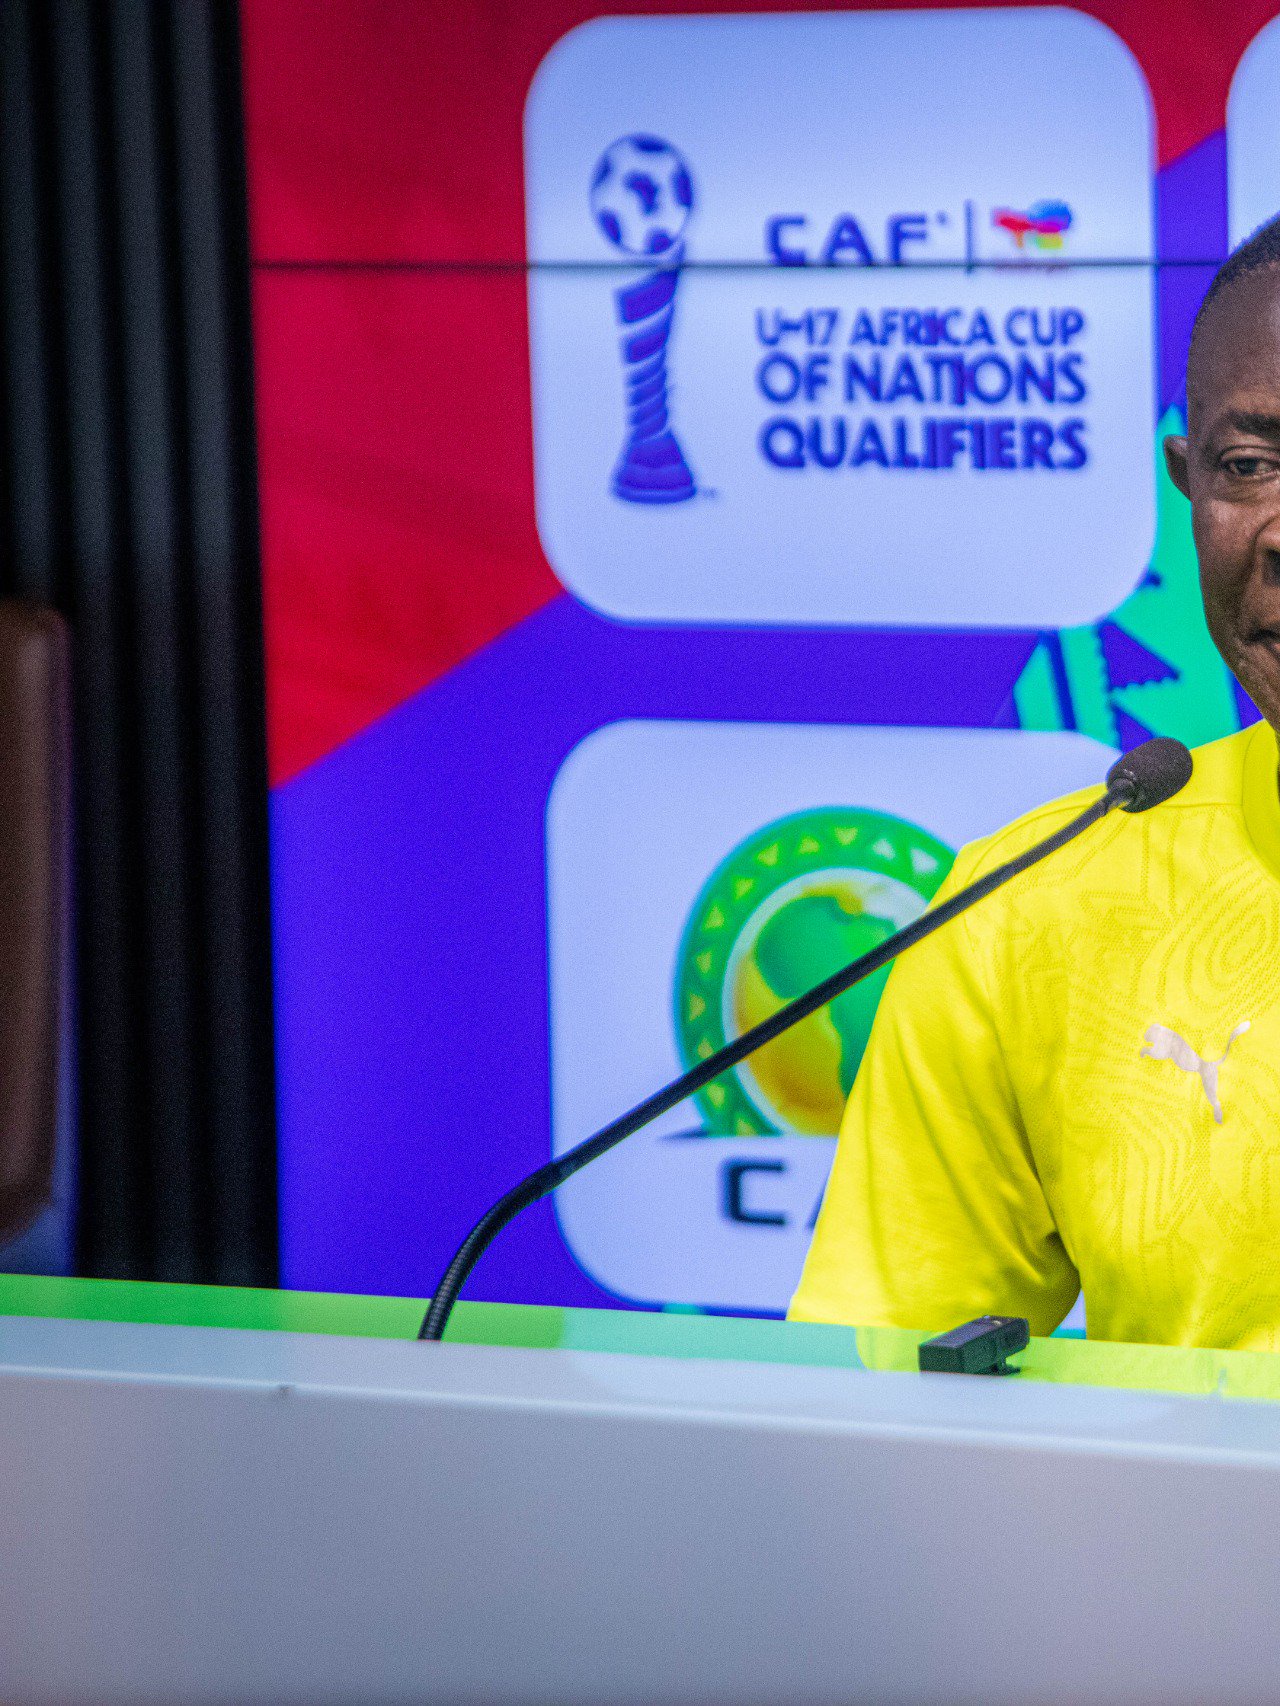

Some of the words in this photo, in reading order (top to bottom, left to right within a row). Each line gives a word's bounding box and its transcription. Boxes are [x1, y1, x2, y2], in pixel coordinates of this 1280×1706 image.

[765, 211, 928, 267] CAF
[754, 306, 840, 346] U-17
[850, 305, 996, 346] AFRICA
[1004, 305, 1086, 346] CUP
[755, 352, 830, 404] OF
[843, 351, 1086, 404] NATIONS
[757, 416, 1088, 470] QUALIFIERS
